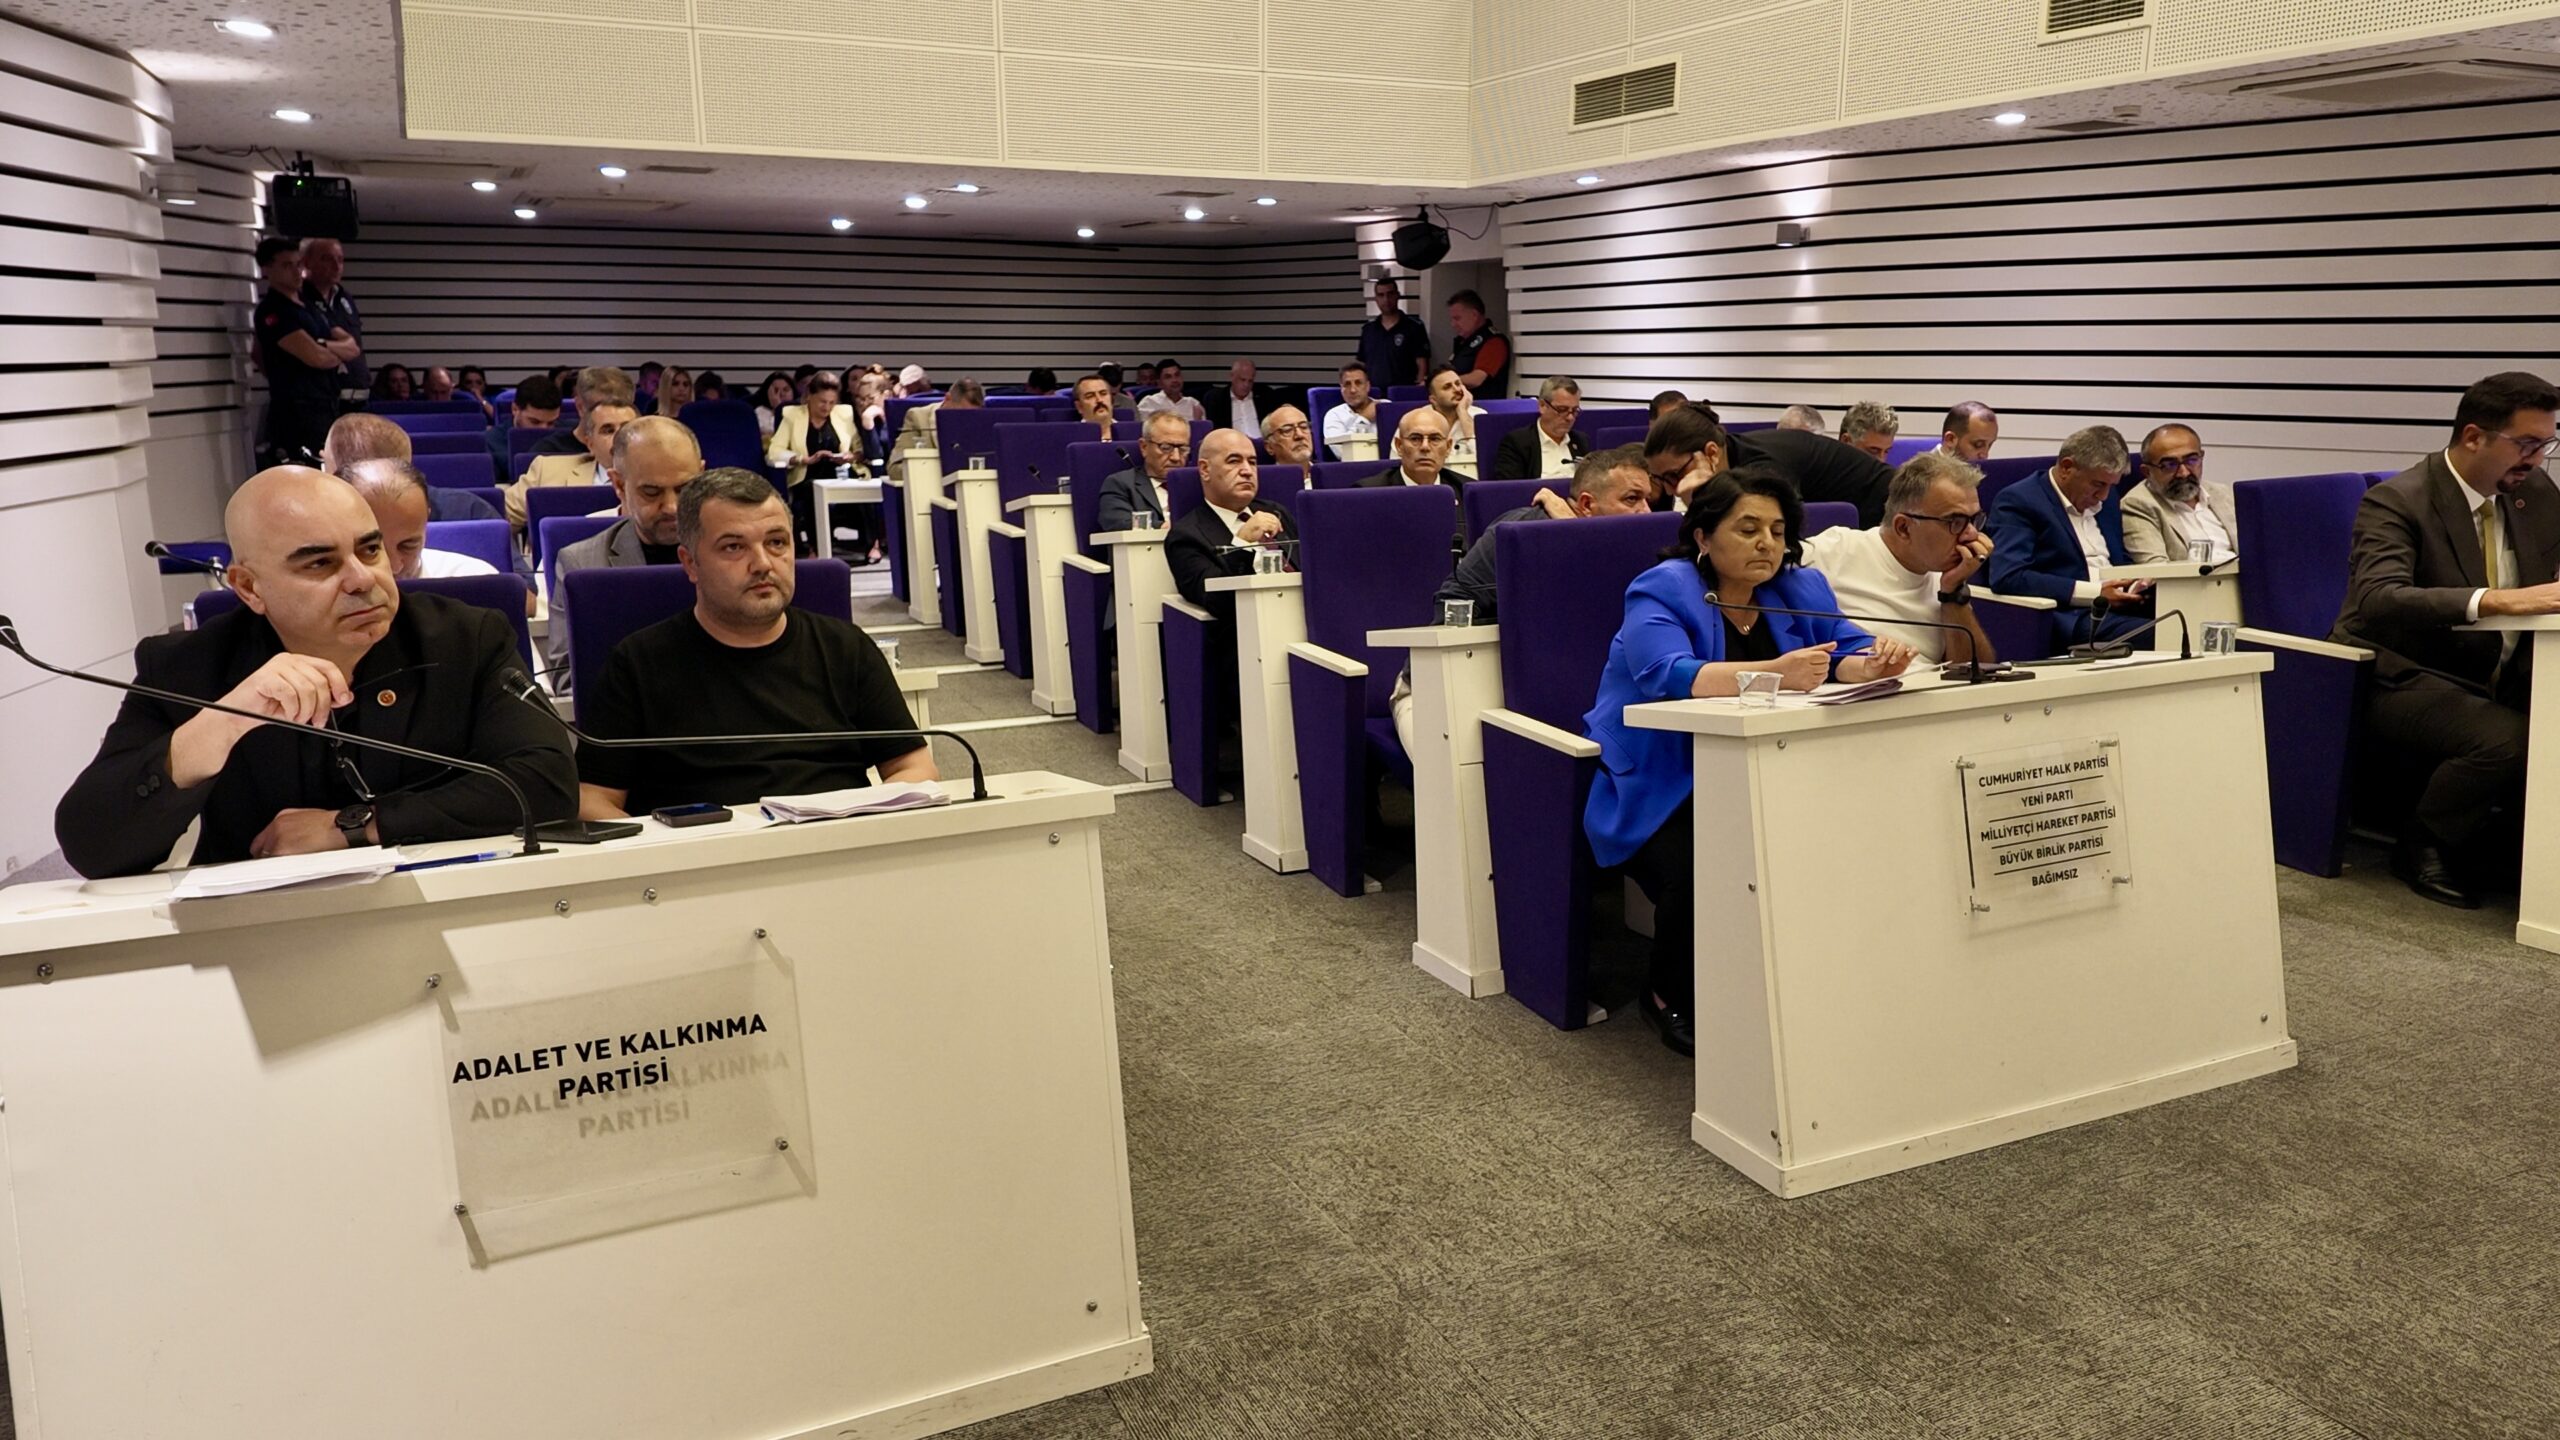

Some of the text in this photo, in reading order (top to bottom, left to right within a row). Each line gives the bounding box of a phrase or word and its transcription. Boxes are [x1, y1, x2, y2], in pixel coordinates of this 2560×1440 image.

[1979, 754, 2108, 787] CUMHURİYET HALK PARTİSİ
[2021, 792, 2043, 807] YENİ
[1981, 806, 2116, 842] MİLLİYETÇİ HAREKET PARTİSİ
[2000, 834, 2103, 865] BÜYÜK BİRLİK PARTİSİ
[2032, 868, 2078, 886] BAĞIMSIZ
[453, 1014, 766, 1083] ADALET VE KALKINMA
[559, 1057, 668, 1099] PARTİSİ
